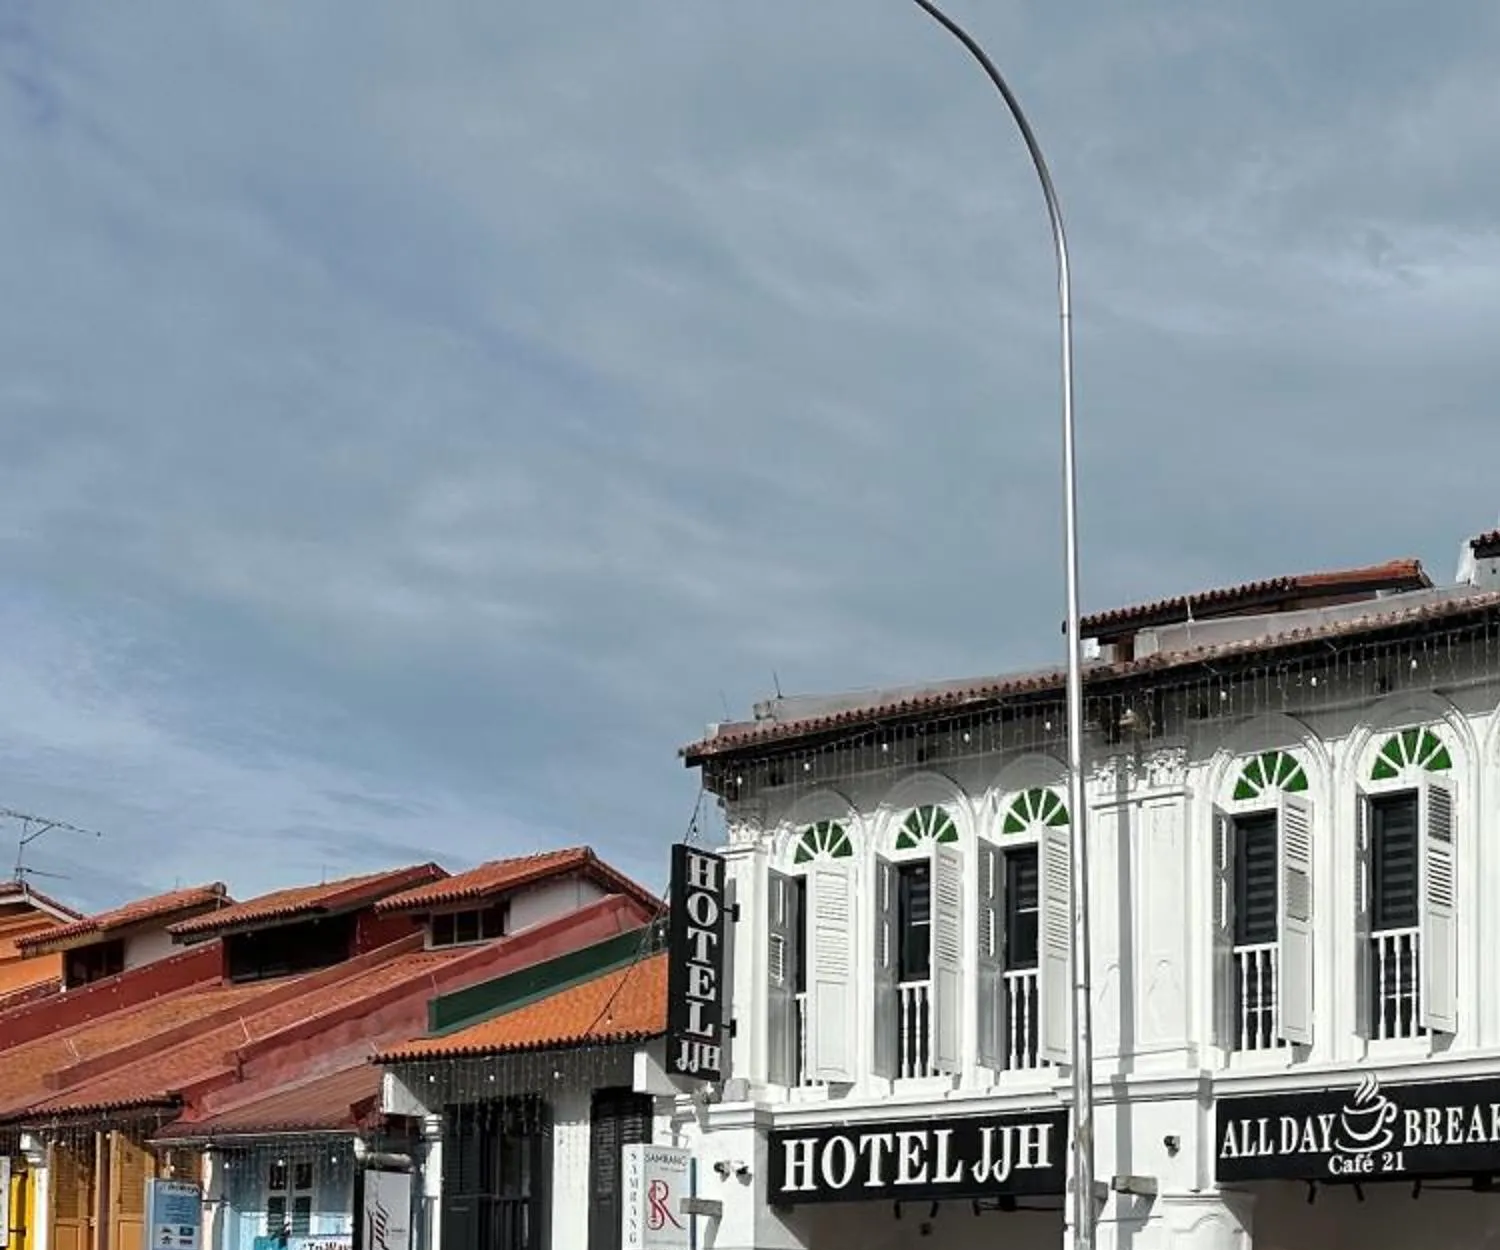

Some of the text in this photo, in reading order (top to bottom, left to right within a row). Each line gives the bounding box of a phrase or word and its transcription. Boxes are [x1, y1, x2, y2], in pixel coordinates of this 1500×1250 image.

[686, 852, 719, 1038] HOTEL
[676, 1039, 720, 1072] JJH
[780, 1123, 1054, 1192] HOTEL JJH
[1220, 1117, 1273, 1158] ALL
[1281, 1113, 1336, 1154] DAY
[1328, 1150, 1406, 1174] Café 21
